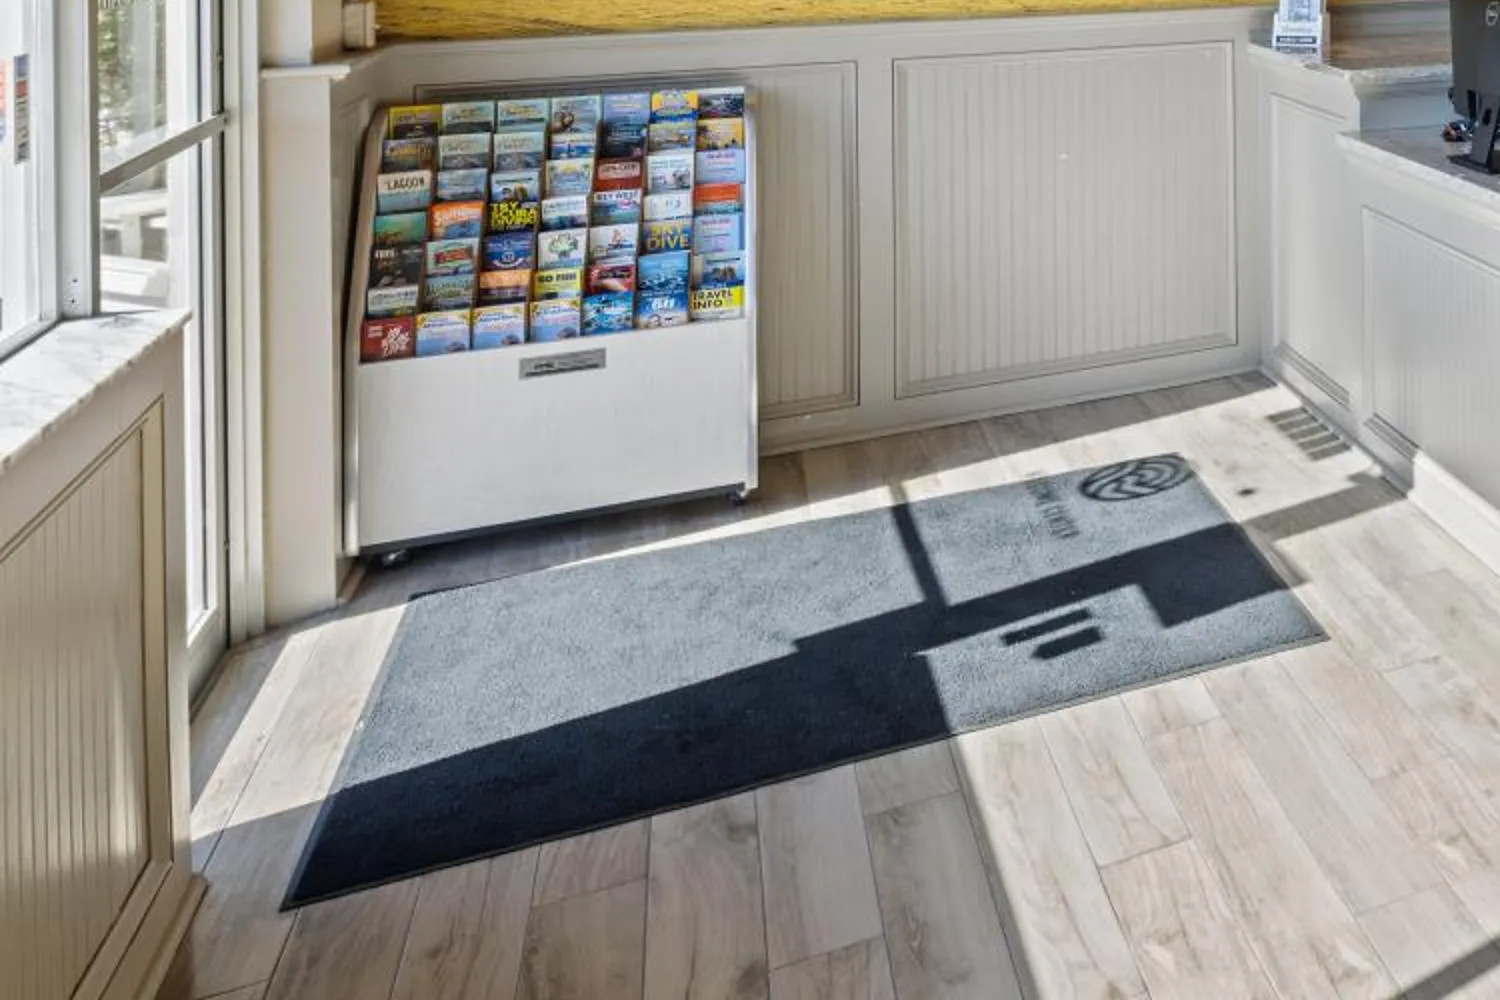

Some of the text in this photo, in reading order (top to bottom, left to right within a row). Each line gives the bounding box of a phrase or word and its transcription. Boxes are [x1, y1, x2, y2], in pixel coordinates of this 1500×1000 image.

[648, 235, 689, 250] DIVE
[692, 289, 733, 300] TRAVEL
[693, 299, 723, 310] INFO
